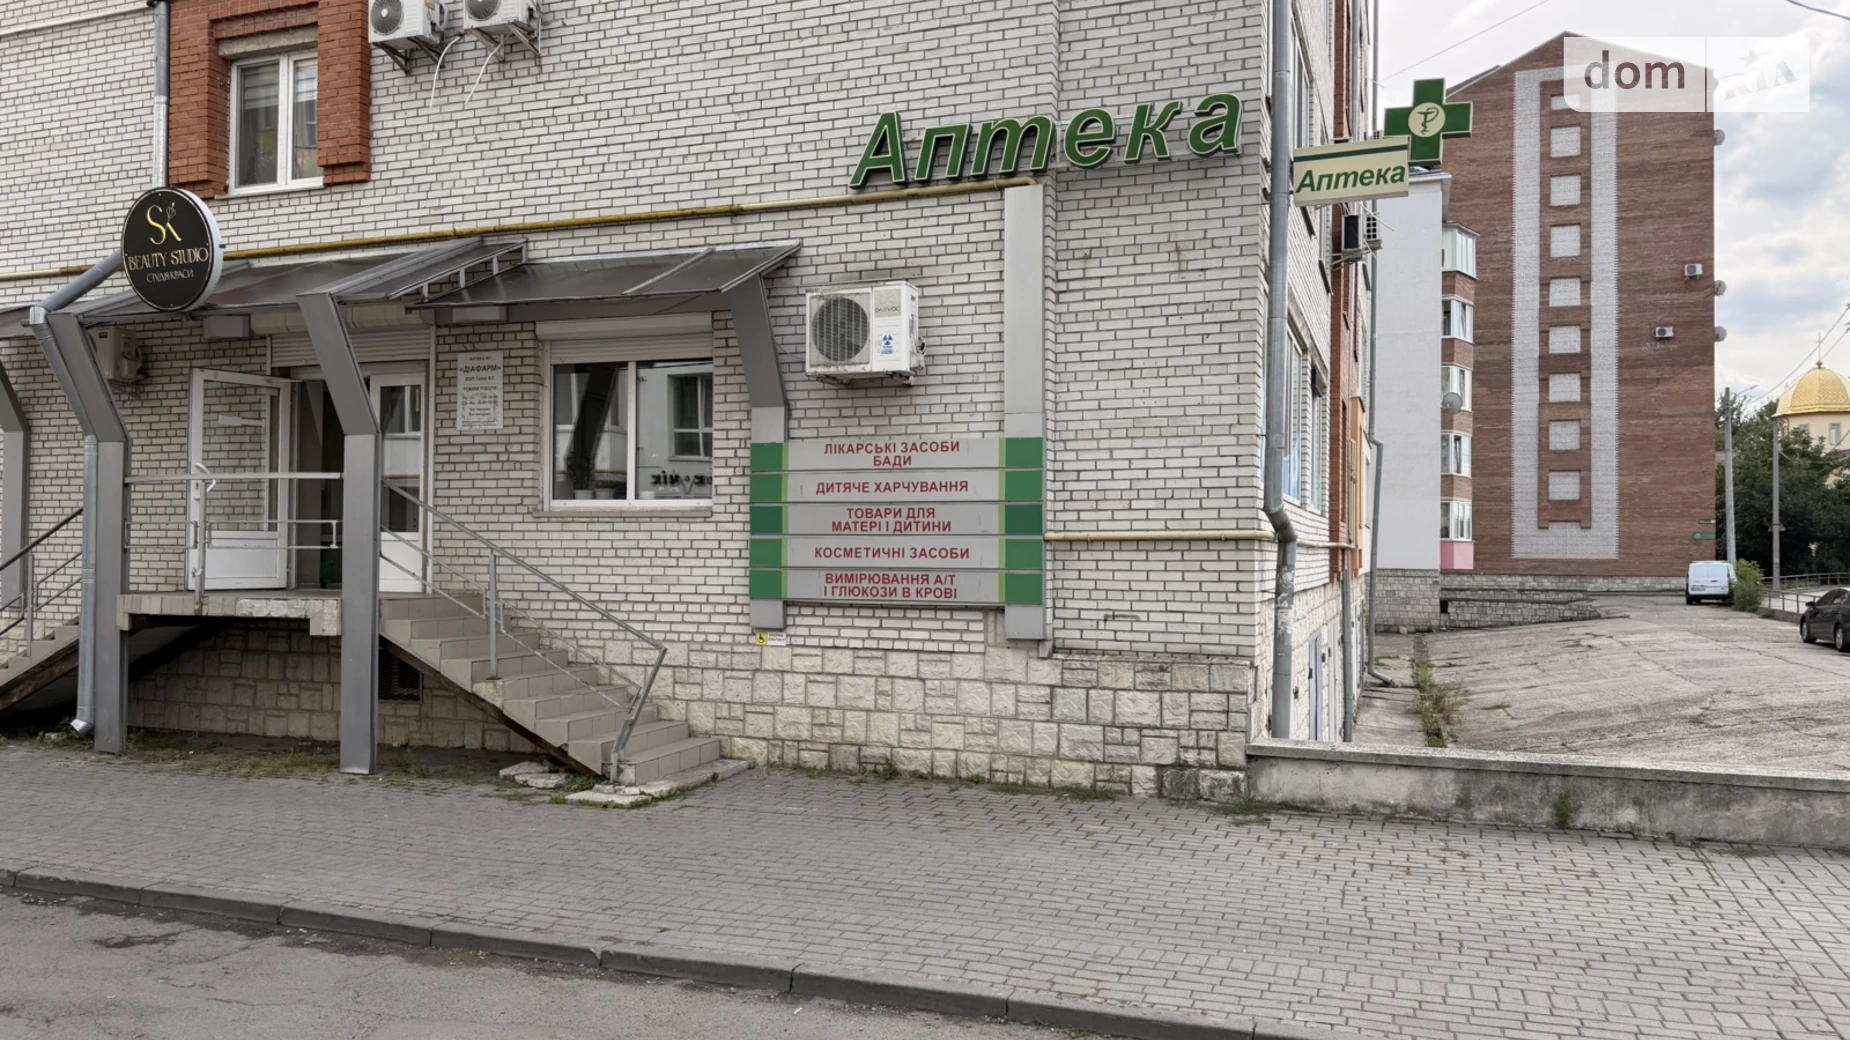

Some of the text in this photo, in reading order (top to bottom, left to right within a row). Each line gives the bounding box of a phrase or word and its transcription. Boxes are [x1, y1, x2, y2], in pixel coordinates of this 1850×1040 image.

[849, 92, 1244, 190] Аптека
[1295, 165, 1406, 193] Аптека
[127, 247, 209, 271] BEAUTY STUDIO
[824, 441, 960, 454] ЛІКАРСЬКІ ЗАСОБИ
[873, 455, 912, 468] БАДИ
[816, 481, 968, 495] ДИТЯЧЕ ХАРЧУВАННЯ
[846, 507, 935, 520] ТОВАРИ ДЛЯ
[832, 521, 952, 534] МАТЕРІ І ДИТИНИ
[815, 547, 969, 559] КОСМЕТИЧНІ ЗАСОБИ
[825, 573, 956, 586] ВИМІРЮВАННЯ А/Т
[824, 586, 957, 599] І ГЛЮКОЗИ В КРОВІ
